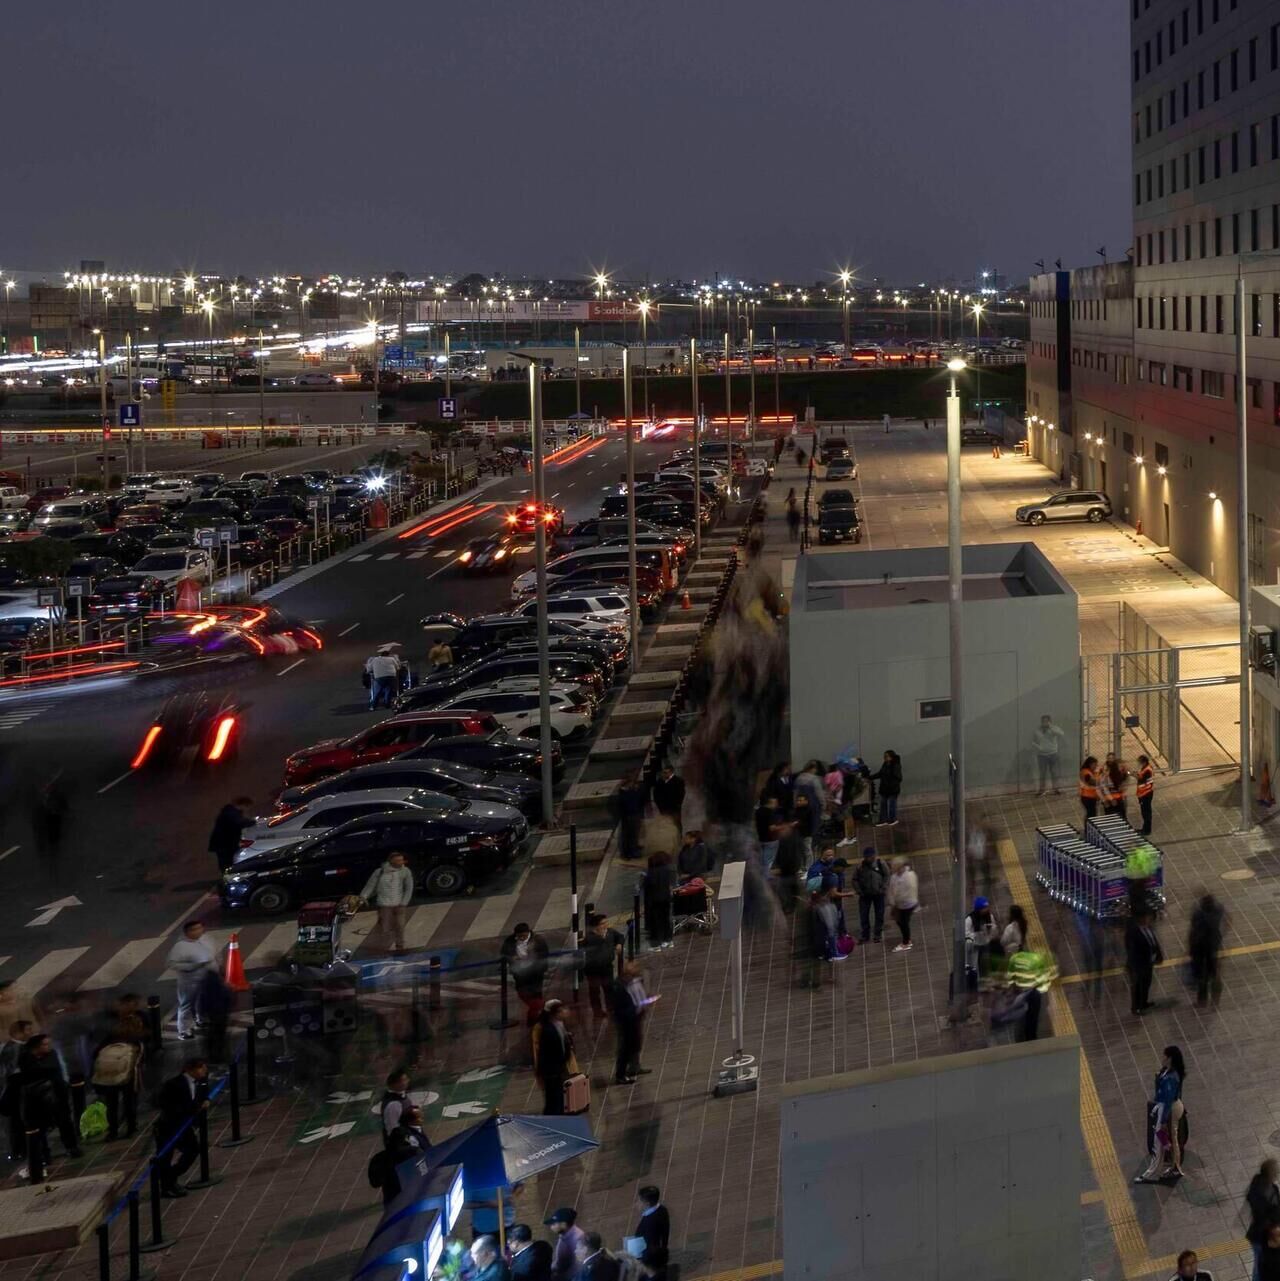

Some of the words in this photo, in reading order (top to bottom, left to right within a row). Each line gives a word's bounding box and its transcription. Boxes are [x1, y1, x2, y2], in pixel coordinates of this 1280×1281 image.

[594, 305, 641, 316] Scotiaba
[442, 400, 454, 411] H
[527, 1140, 567, 1161] apparka
